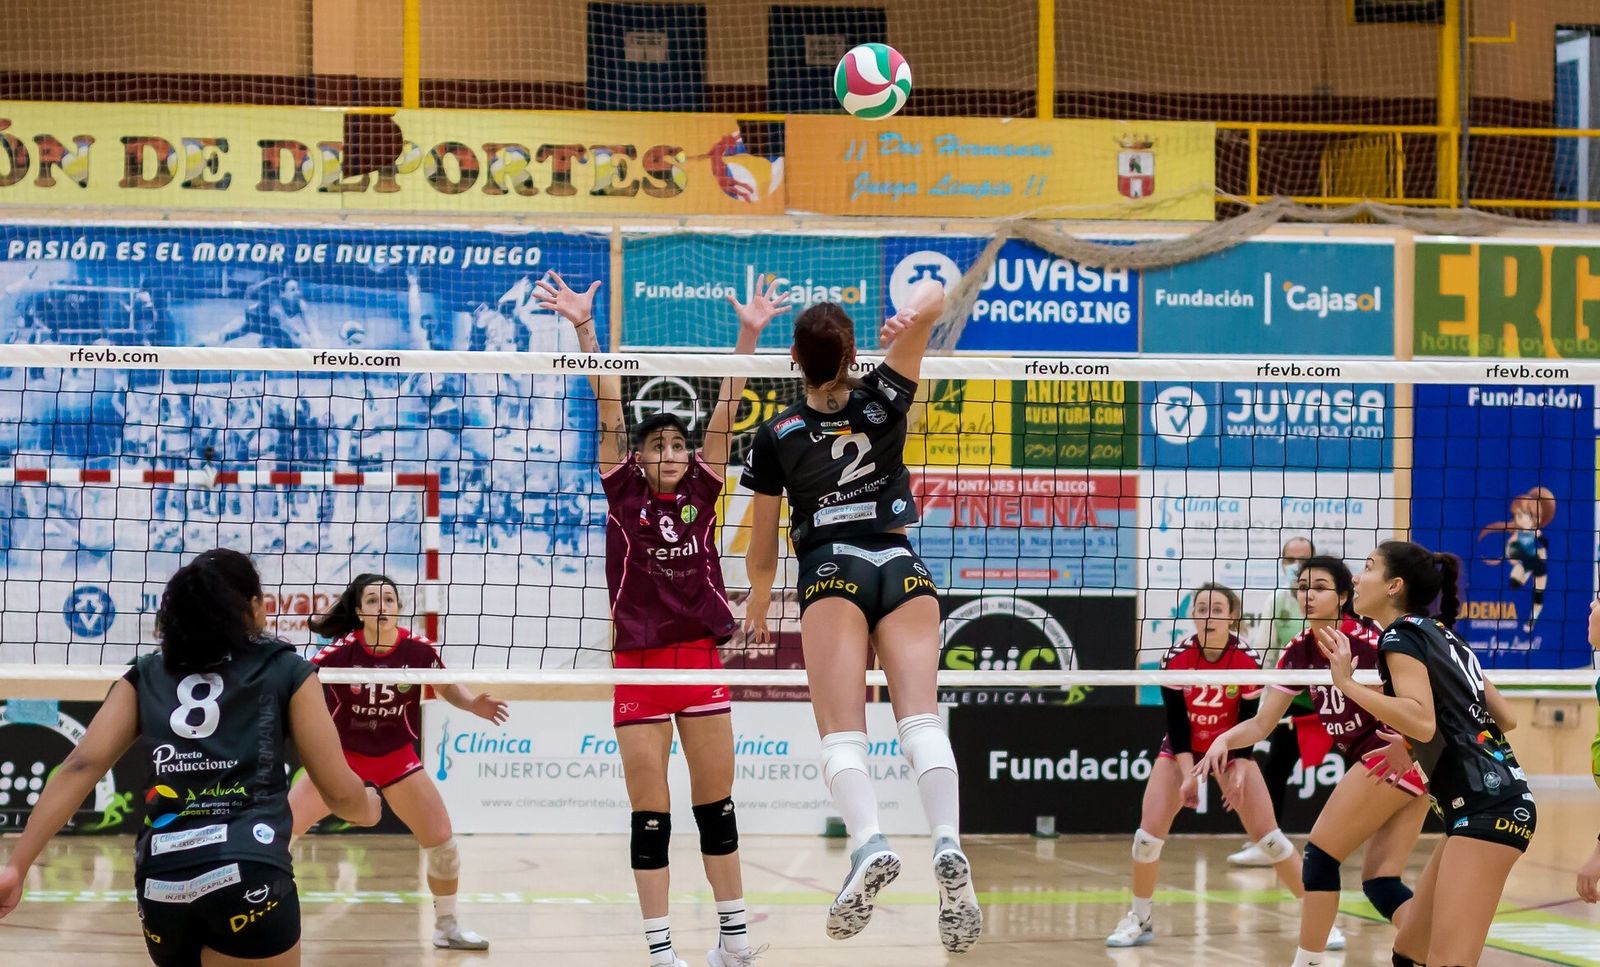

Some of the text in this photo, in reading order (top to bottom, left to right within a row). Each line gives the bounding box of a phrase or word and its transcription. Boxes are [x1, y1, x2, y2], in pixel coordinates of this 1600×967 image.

[879, 132, 922, 156] Dos
[934, 133, 1053, 158] Hermanas
[118, 136, 231, 191] DE
[850, 172, 918, 201] Juega
[928, 175, 1012, 201] Limpio
[8, 236, 542, 269] PASIÓN ES EL MOTOR DE NUESTRO JUEGO
[979, 258, 1129, 294] JUVASA
[634, 275, 867, 308] Fundación Cajasol
[1155, 284, 1381, 318] Fundación Cajasol
[972, 299, 1131, 324] PACKAGING
[69, 349, 159, 363] rfevb.com
[313, 352, 401, 367] rfevb.com
[552, 356, 640, 370] rfevb.com
[1025, 361, 1110, 375] rfevb.com
[1256, 363, 1341, 378] rfevb.com
[1486, 365, 1569, 379] rfevb.com
[1226, 388, 1384, 424] JUVASA
[1467, 386, 1582, 410] Fundación
[1025, 407, 1126, 425] AVENTURA.COM
[1227, 424, 1384, 444] www.juvasa.com
[831, 432, 876, 487] 2
[947, 476, 1096, 494] MONTAJES ELÉCTRICOS
[947, 496, 1100, 529] INELNA
[1173, 496, 1363, 514] Clínica Frontela
[658, 515, 679, 543] 8
[646, 535, 699, 561] renal
[805, 577, 858, 600] Divisa
[1457, 602, 1518, 619] ADEMIA
[169, 672, 224, 739] 8
[365, 683, 395, 705] 15
[941, 692, 1045, 705] MEDICAL
[1192, 685, 1224, 708] 22
[1318, 685, 1346, 715] 20
[454, 732, 531, 755] Clínica
[735, 734, 788, 755] ínica
[478, 761, 625, 779] INJERTO CAPIL
[736, 763, 817, 780] INJERTO
[989, 750, 1151, 781] Fundació
[480, 799, 633, 809] www.clinicadrfrontela.c
[201, 876, 234, 894] CAPILAR
